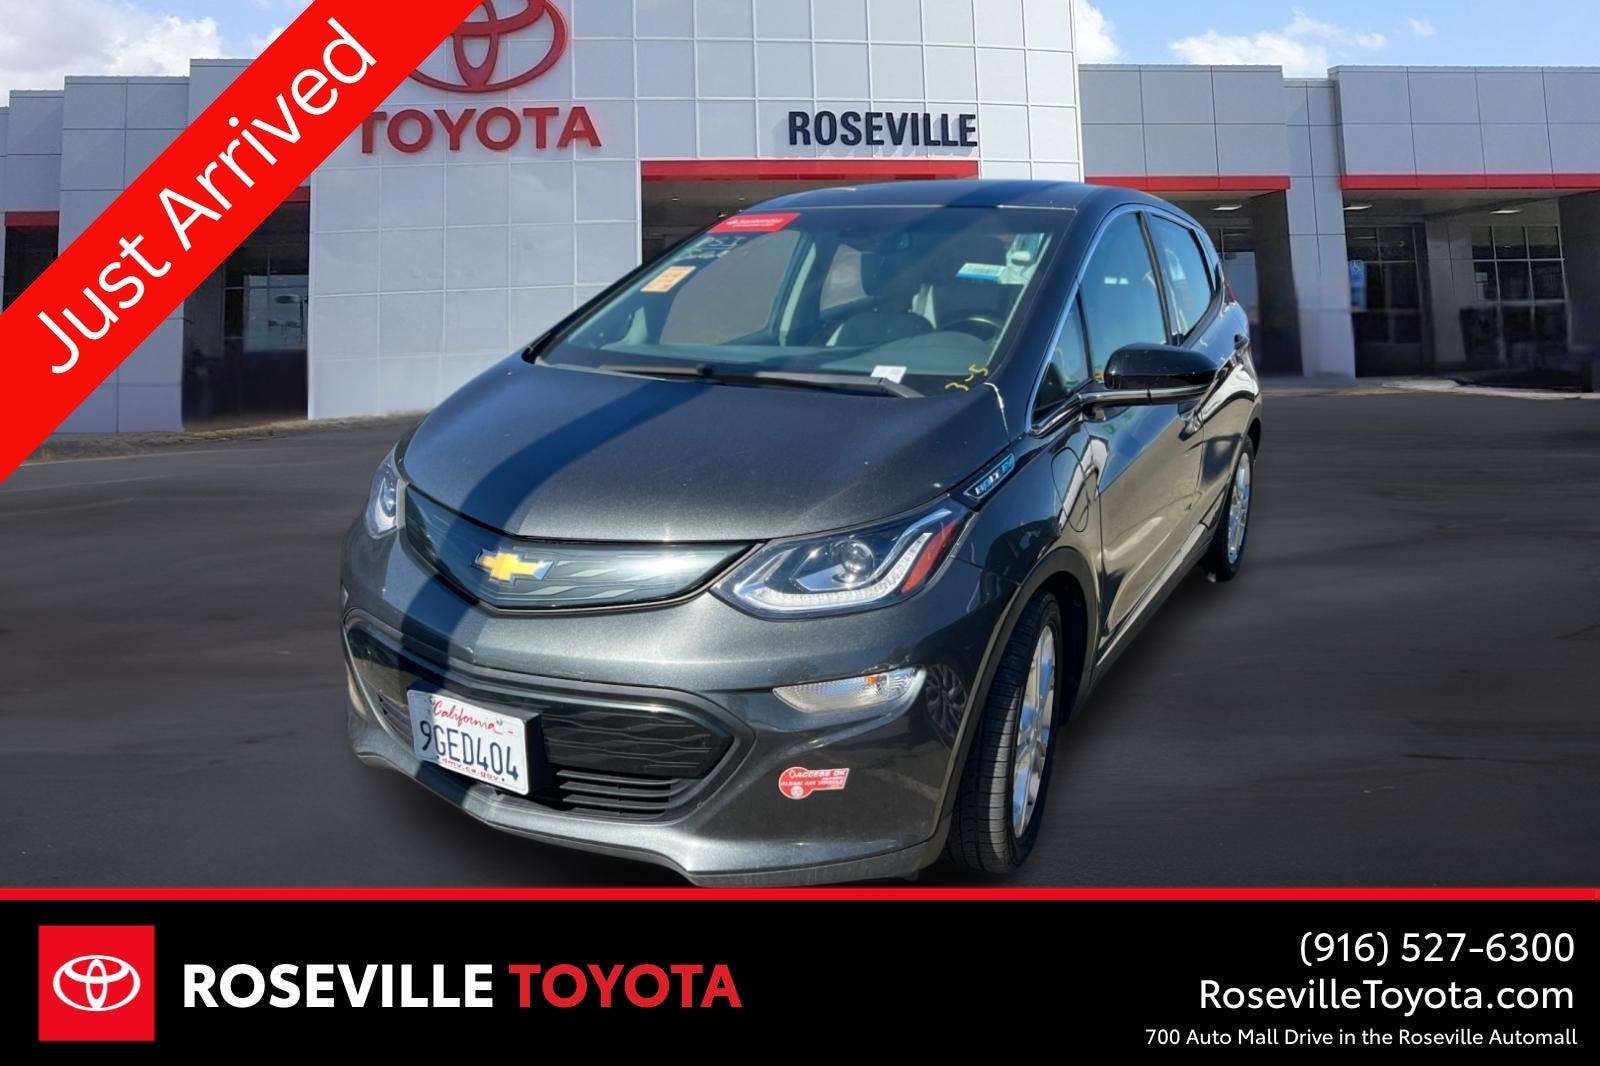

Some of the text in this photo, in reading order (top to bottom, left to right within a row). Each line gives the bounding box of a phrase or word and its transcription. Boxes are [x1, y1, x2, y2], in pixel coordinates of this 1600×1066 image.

[361, 107, 602, 154] TOYOTA
[788, 111, 978, 147] ROSEVILLE
[433, 700, 503, 735] California
[420, 720, 519, 781] 9GED404
